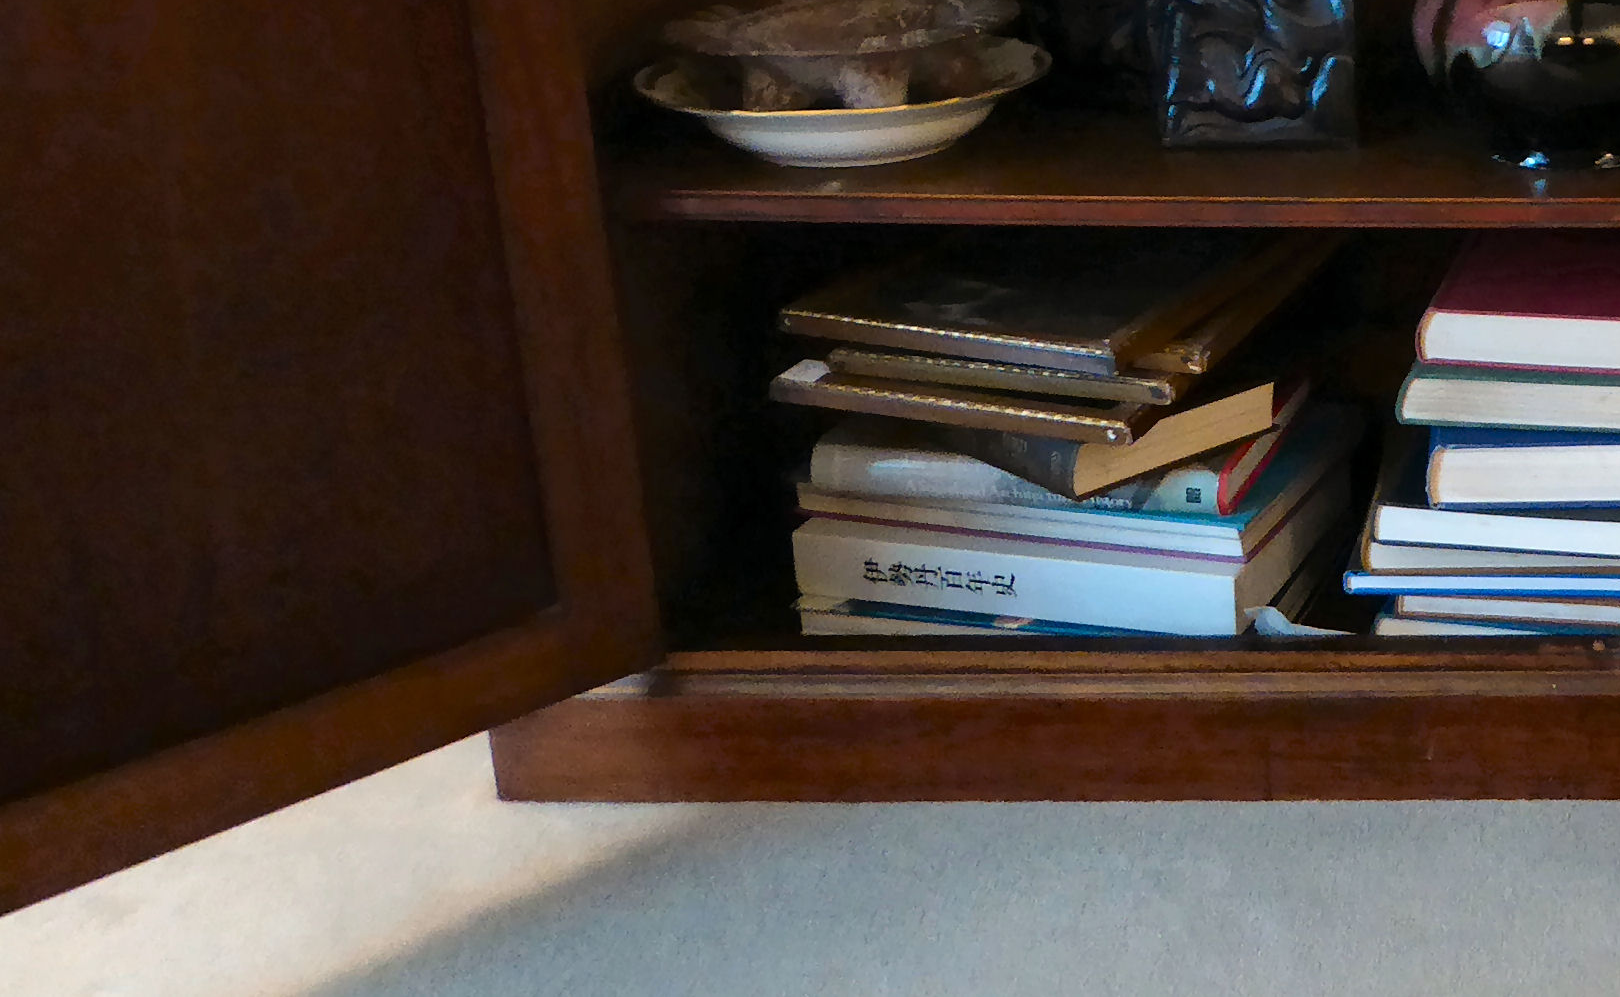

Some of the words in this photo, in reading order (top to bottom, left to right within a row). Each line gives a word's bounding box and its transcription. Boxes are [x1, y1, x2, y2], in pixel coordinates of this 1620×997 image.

[863, 557, 1018, 598] 伊勢丹百年史
